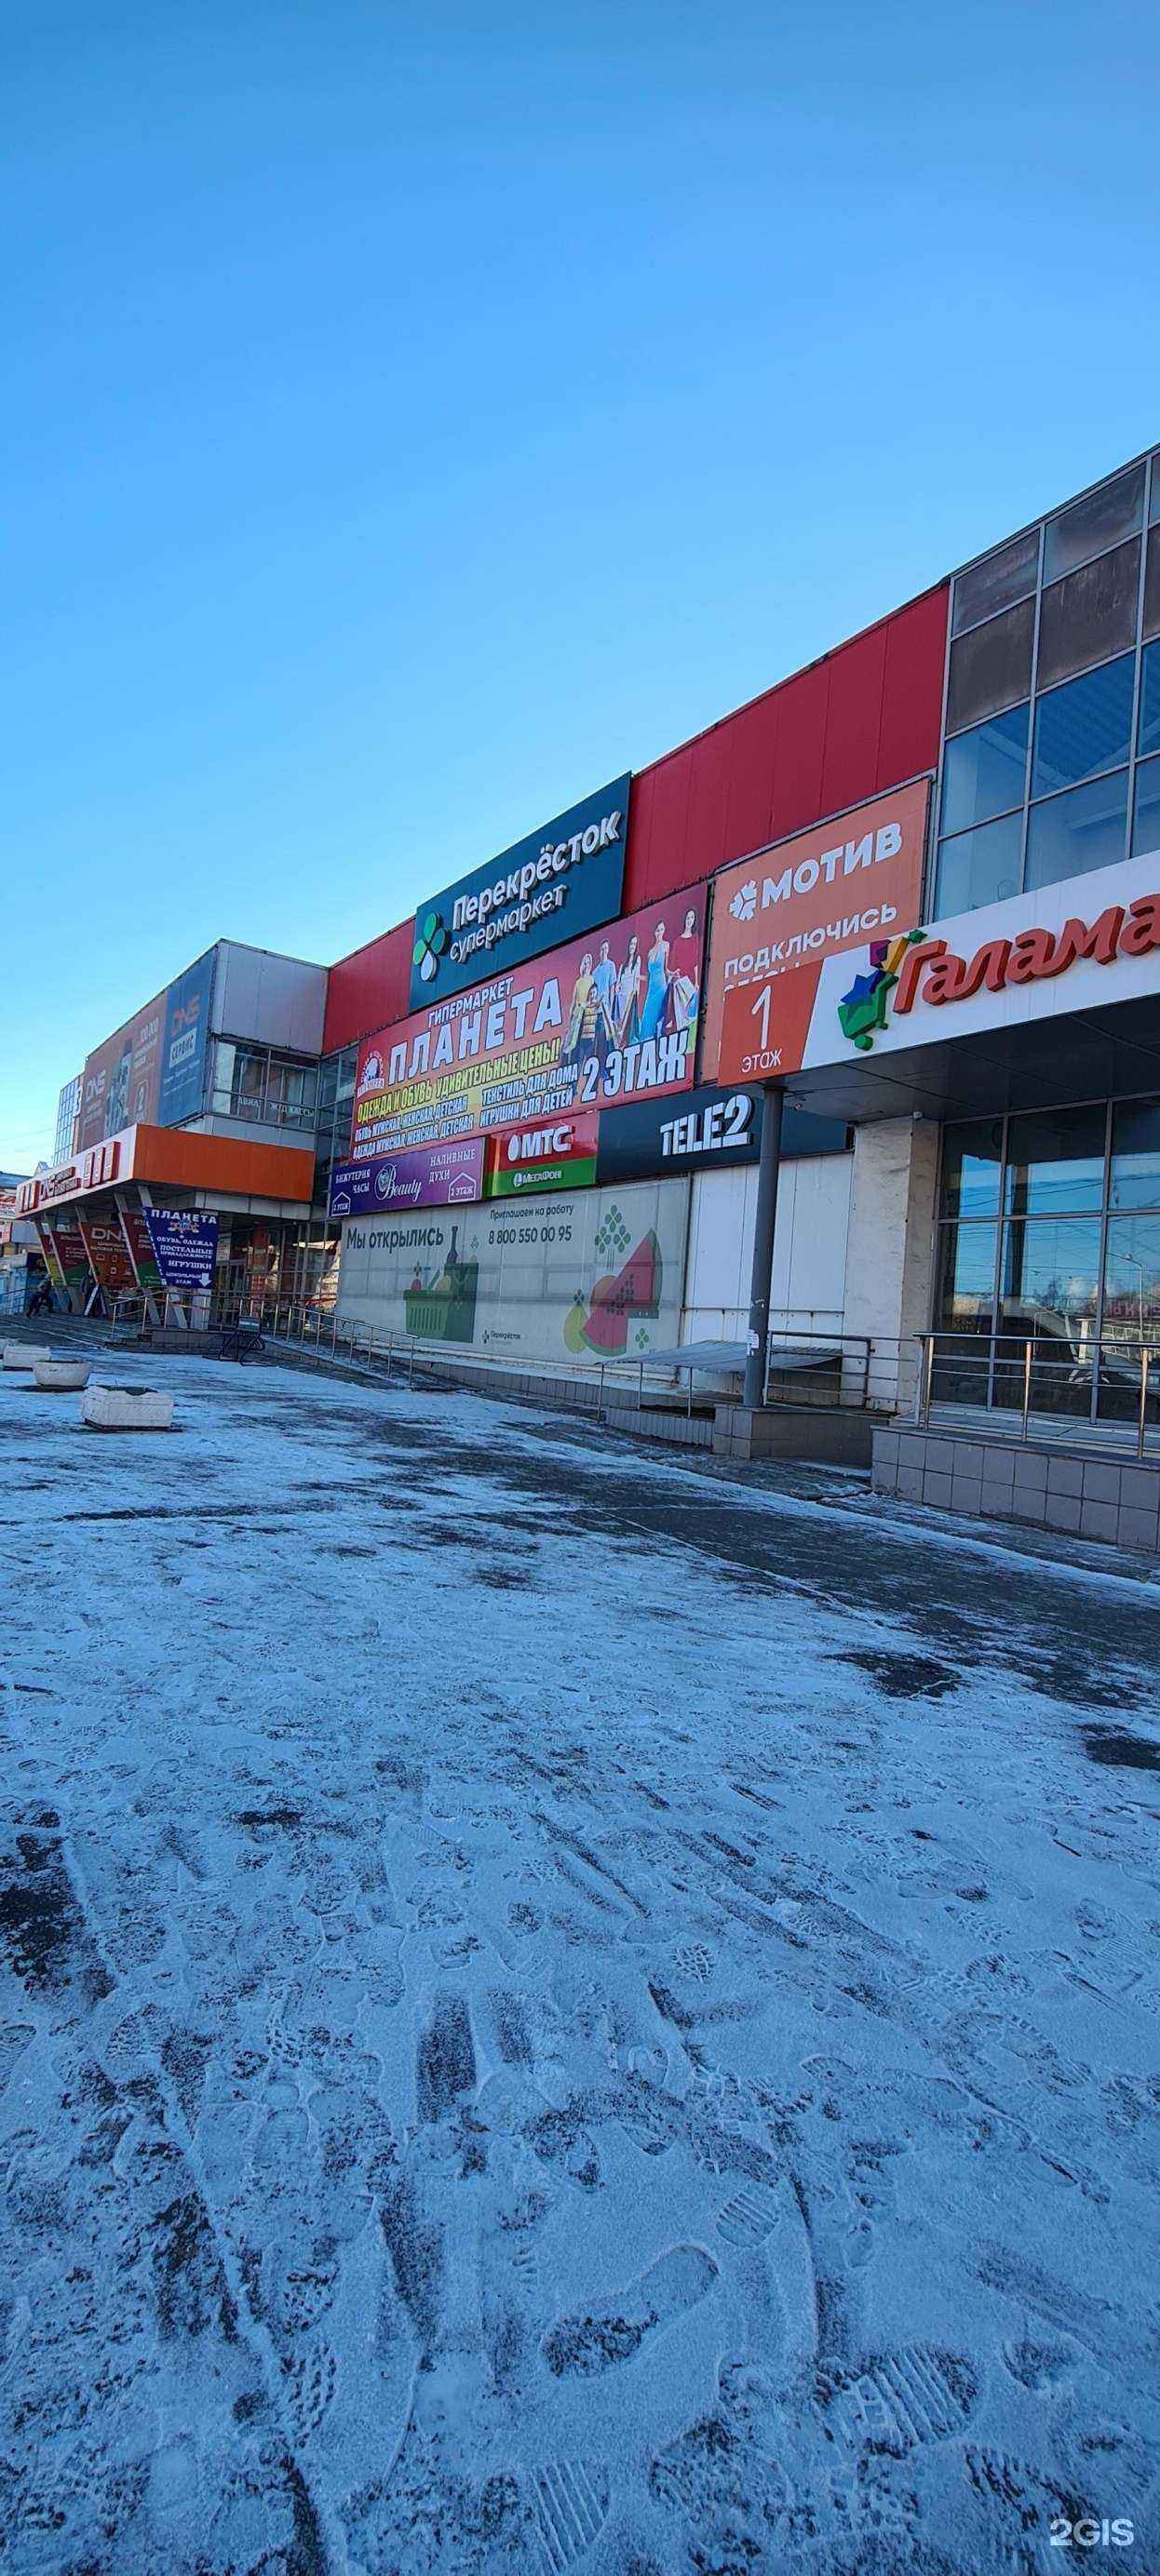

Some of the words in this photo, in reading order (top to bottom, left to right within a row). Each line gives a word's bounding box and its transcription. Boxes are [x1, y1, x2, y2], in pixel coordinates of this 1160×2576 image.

[452, 811, 621, 931] Перекрёсток
[760, 822, 902, 908] МОТИВ
[450, 883, 568, 963] супермаркет
[892, 892, 1160, 1015] Галама
[428, 976, 514, 1028] ГИПЕРМАРКЕТ
[751, 984, 772, 1052] 1
[387, 977, 563, 1087] ПЛАНЕТА
[481, 1080, 526, 1107] ТЕКСТИЛЬ
[526, 1074, 548, 1096] ДЛЯ
[548, 1063, 579, 1090] ДОМА
[581, 1055, 600, 1103] 2
[604, 1028, 688, 1096] ЭТАЖ
[357, 1092, 393, 1124] ОДЕЖДА
[400, 1080, 433, 1110] ОБУВЬ
[436, 1051, 519, 1099] УДИВИТЕЛЬНЫЕ
[479, 1098, 520, 1128] ИГРУШКИ
[520, 1093, 542, 1120] ДЛЯ
[542, 1086, 574, 1112] ДЕТЕЙ
[435, 1095, 468, 1122] ДЕТСКАЯ
[439, 1113, 474, 1140] ДЕТСКАЯ
[660, 1094, 752, 1156] TELE2
[430, 1148, 477, 1167] НАЛИВНЫЕ
[520, 1125, 572, 1160] МТС
[335, 1169, 371, 1185] БИЖУТЕРИЯ
[375, 1162, 422, 1202] Beauty
[429, 1169, 450, 1185] ДУХИ
[151, 1209, 217, 1225] ПЛАНЕТА
[491, 1210, 536, 1221] Приглашаем
[546, 1204, 574, 1218] работу
[159, 1245, 214, 1255] ПОСТЕЛЬНЫЕ
[346, 1228, 366, 1249] Мы
[369, 1226, 444, 1254] открылись
[489, 1233, 494, 1244] 8
[496, 1230, 517, 1244] 800
[519, 1228, 538, 1243] 550
[540, 1228, 556, 1242] 00
[558, 1226, 572, 1241] 95
[168, 1260, 212, 1270] ИГРУШКИ
